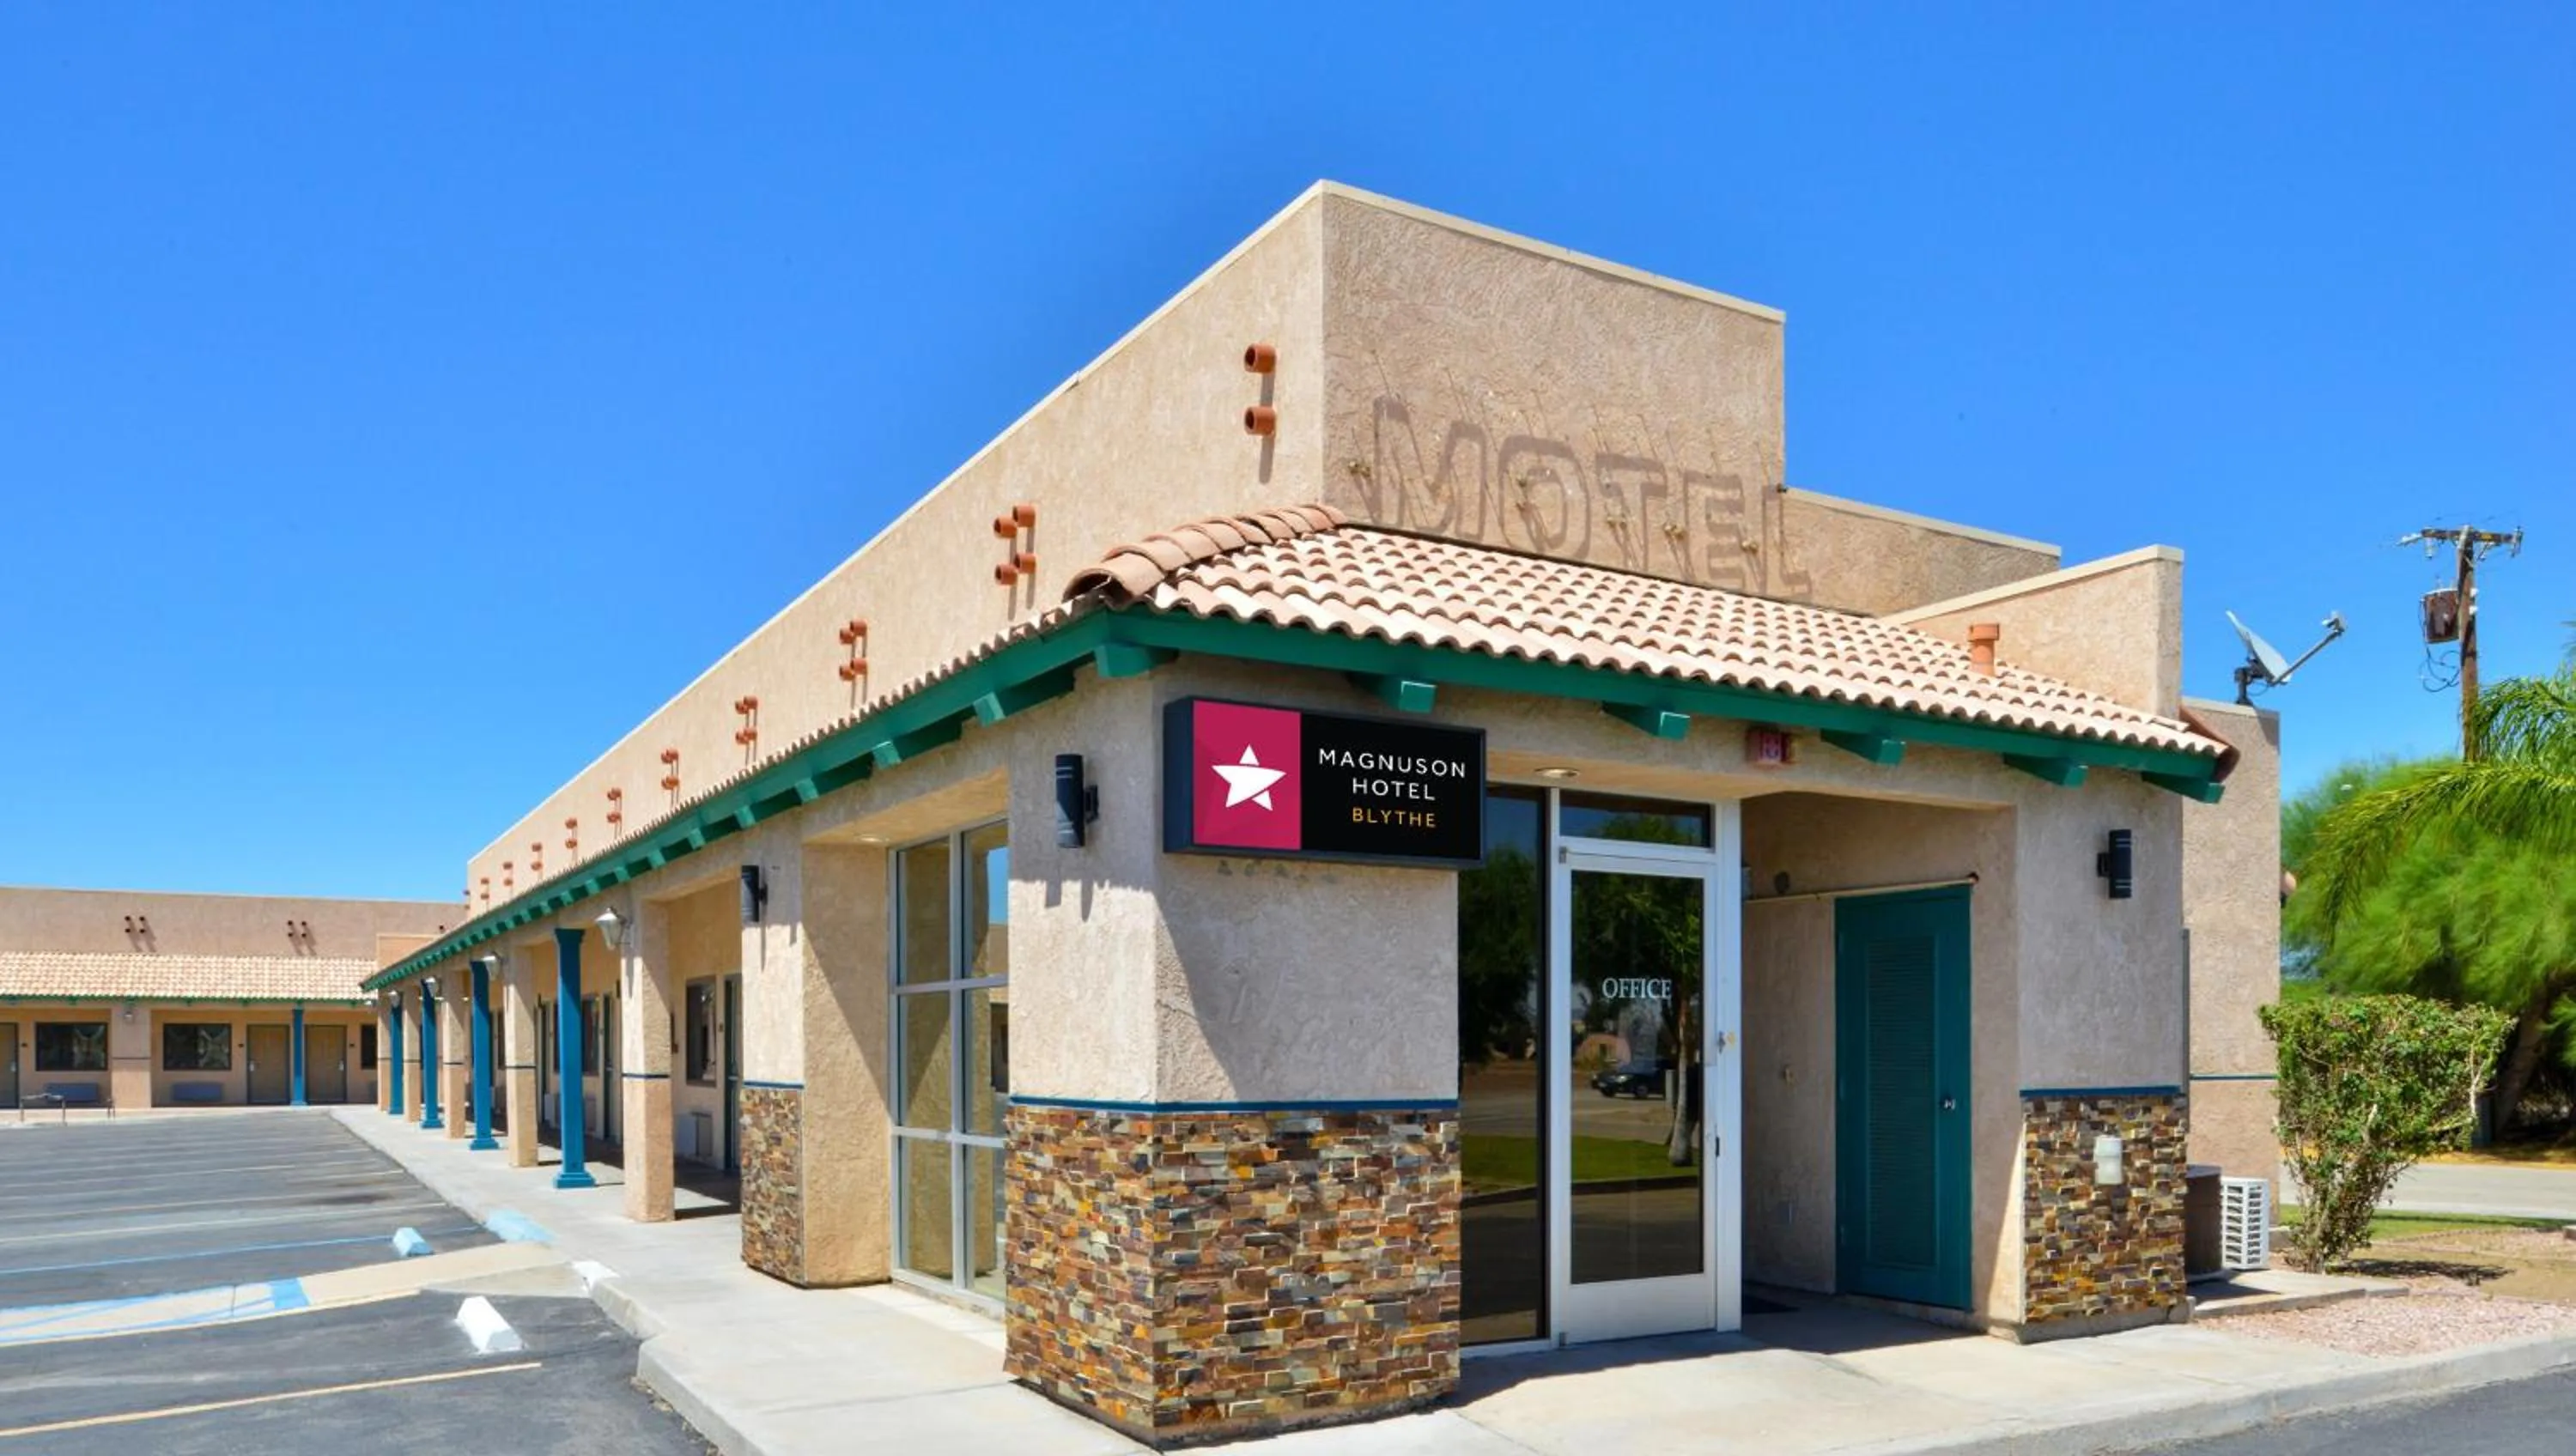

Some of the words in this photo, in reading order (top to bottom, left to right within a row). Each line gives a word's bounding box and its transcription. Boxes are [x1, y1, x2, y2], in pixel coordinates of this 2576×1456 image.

[1372, 393, 1812, 599] MOTEL
[1318, 748, 1466, 779] MAGNUSON
[1352, 778, 1436, 801] HOTEL
[1352, 807, 1437, 828] BLYTHE
[1601, 977, 1672, 999] OFFICE
